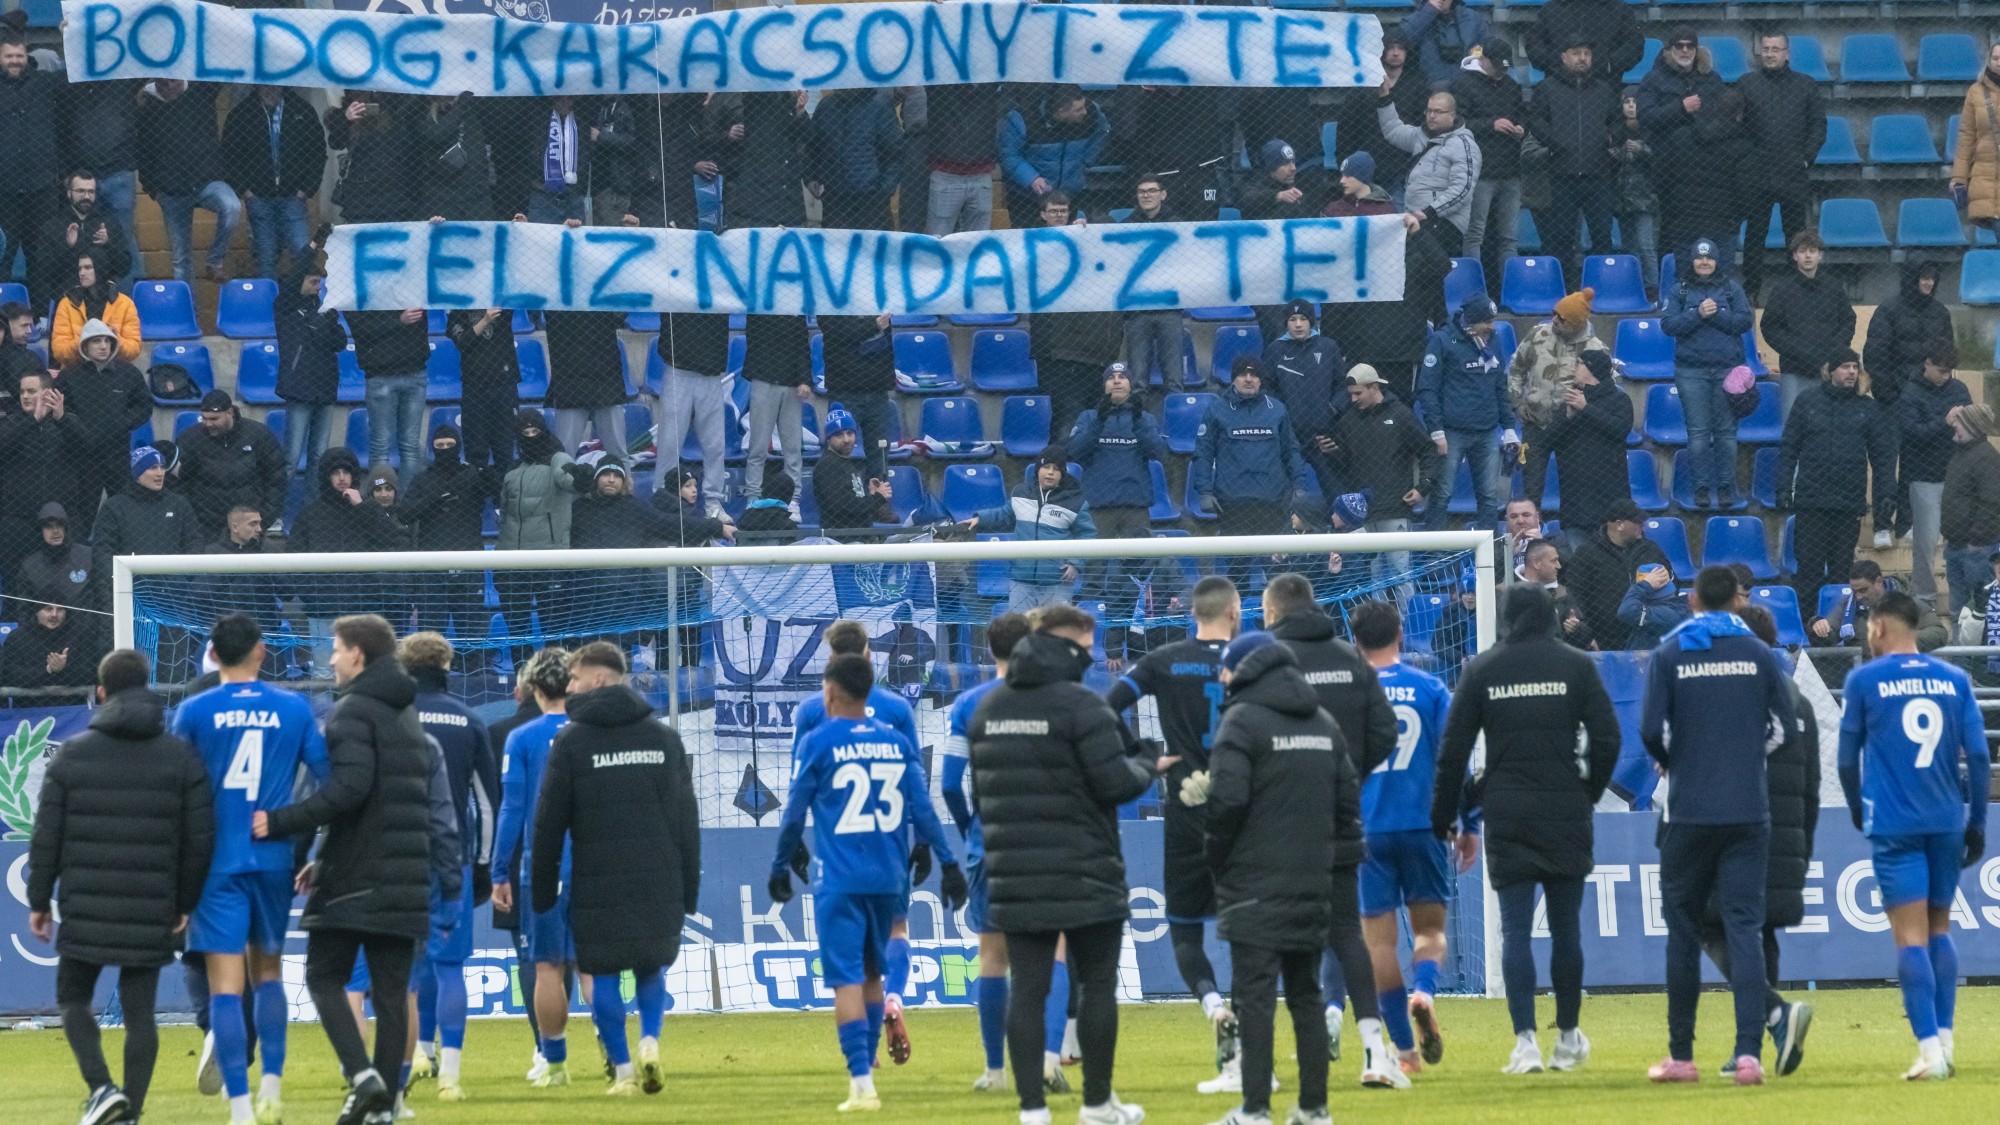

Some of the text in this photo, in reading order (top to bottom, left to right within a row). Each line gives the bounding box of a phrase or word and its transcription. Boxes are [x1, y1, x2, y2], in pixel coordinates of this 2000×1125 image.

[84, 3, 444, 89] BOLDOG
[1119, 9, 1366, 87] ZTE!
[354, 218, 1369, 312] FELIZ NAVIDAD ZTE!
[1304, 670, 1354, 685] AEGERSZEG
[1677, 660, 1757, 679] ZALAEGERSZEG
[1384, 686, 1416, 702] USZ
[1487, 682, 1567, 700] ZALAEGERSZEG
[1878, 677, 1956, 697] DANIEL LIMA
[213, 709, 281, 729] PERAZA
[418, 711, 468, 727] EGERSZEG
[715, 694, 799, 728] KÖLY
[1371, 704, 1422, 774] 9
[1902, 697, 1944, 769] 9
[591, 750, 666, 769] ZALAEGERSZEG
[832, 742, 904, 763] MAXSUELL
[223, 729, 263, 802] 4
[832, 762, 907, 835] 23
